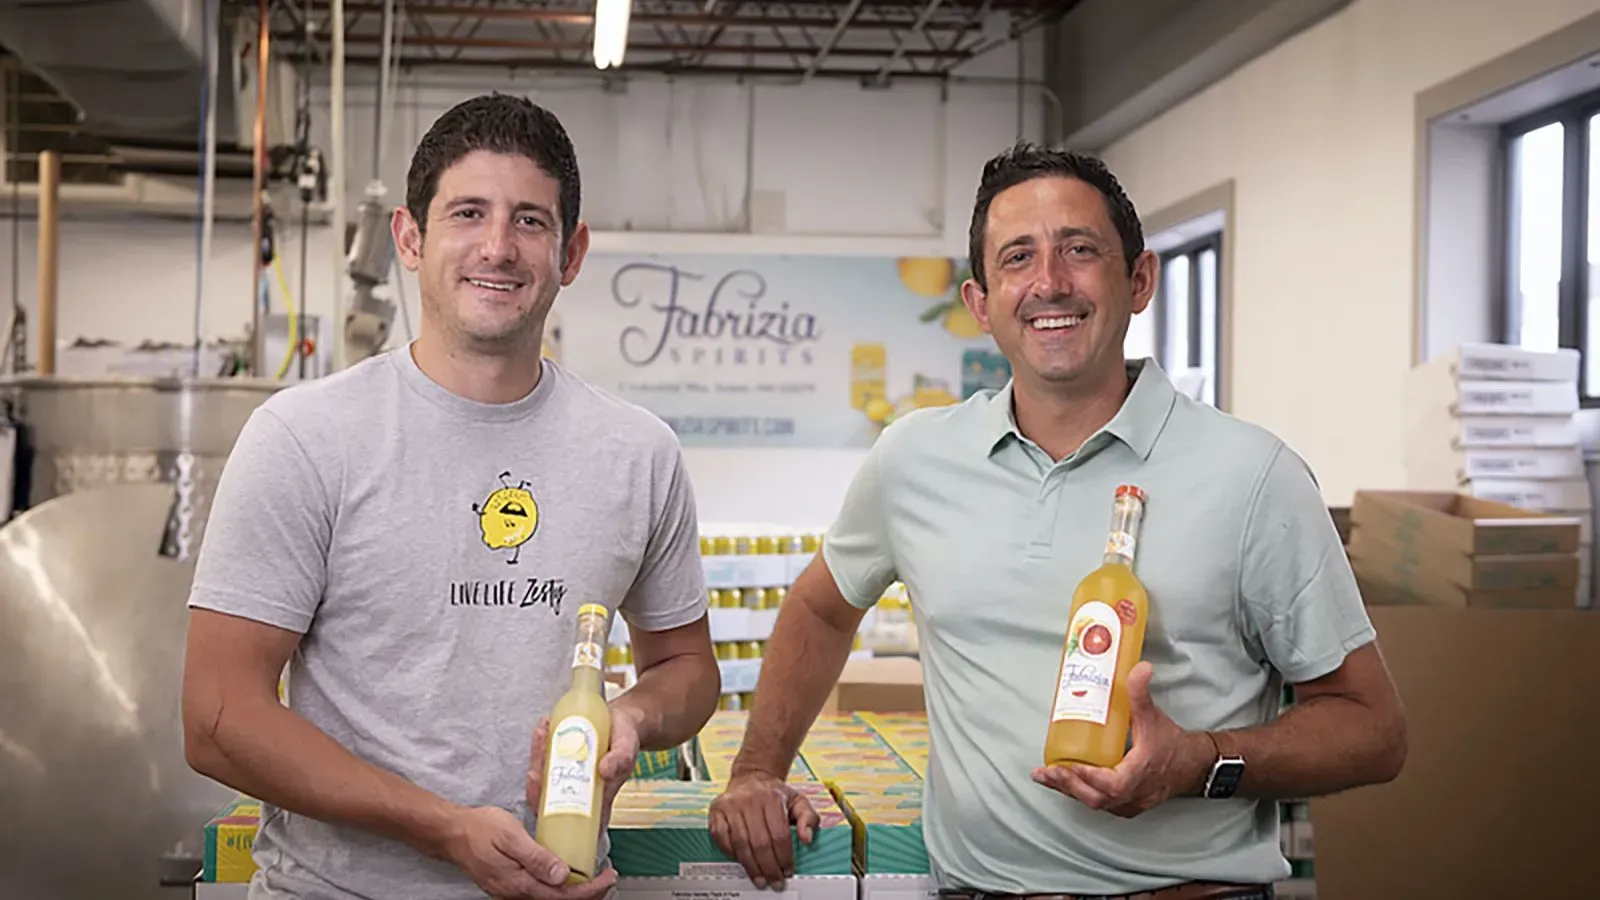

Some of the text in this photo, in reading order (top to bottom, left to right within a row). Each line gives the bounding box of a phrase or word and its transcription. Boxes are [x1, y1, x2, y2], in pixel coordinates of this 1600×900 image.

[612, 262, 820, 367] Fabrizia
[669, 348, 814, 365] SPIRITS
[451, 578, 567, 615] LIVE LIFE Zesty
